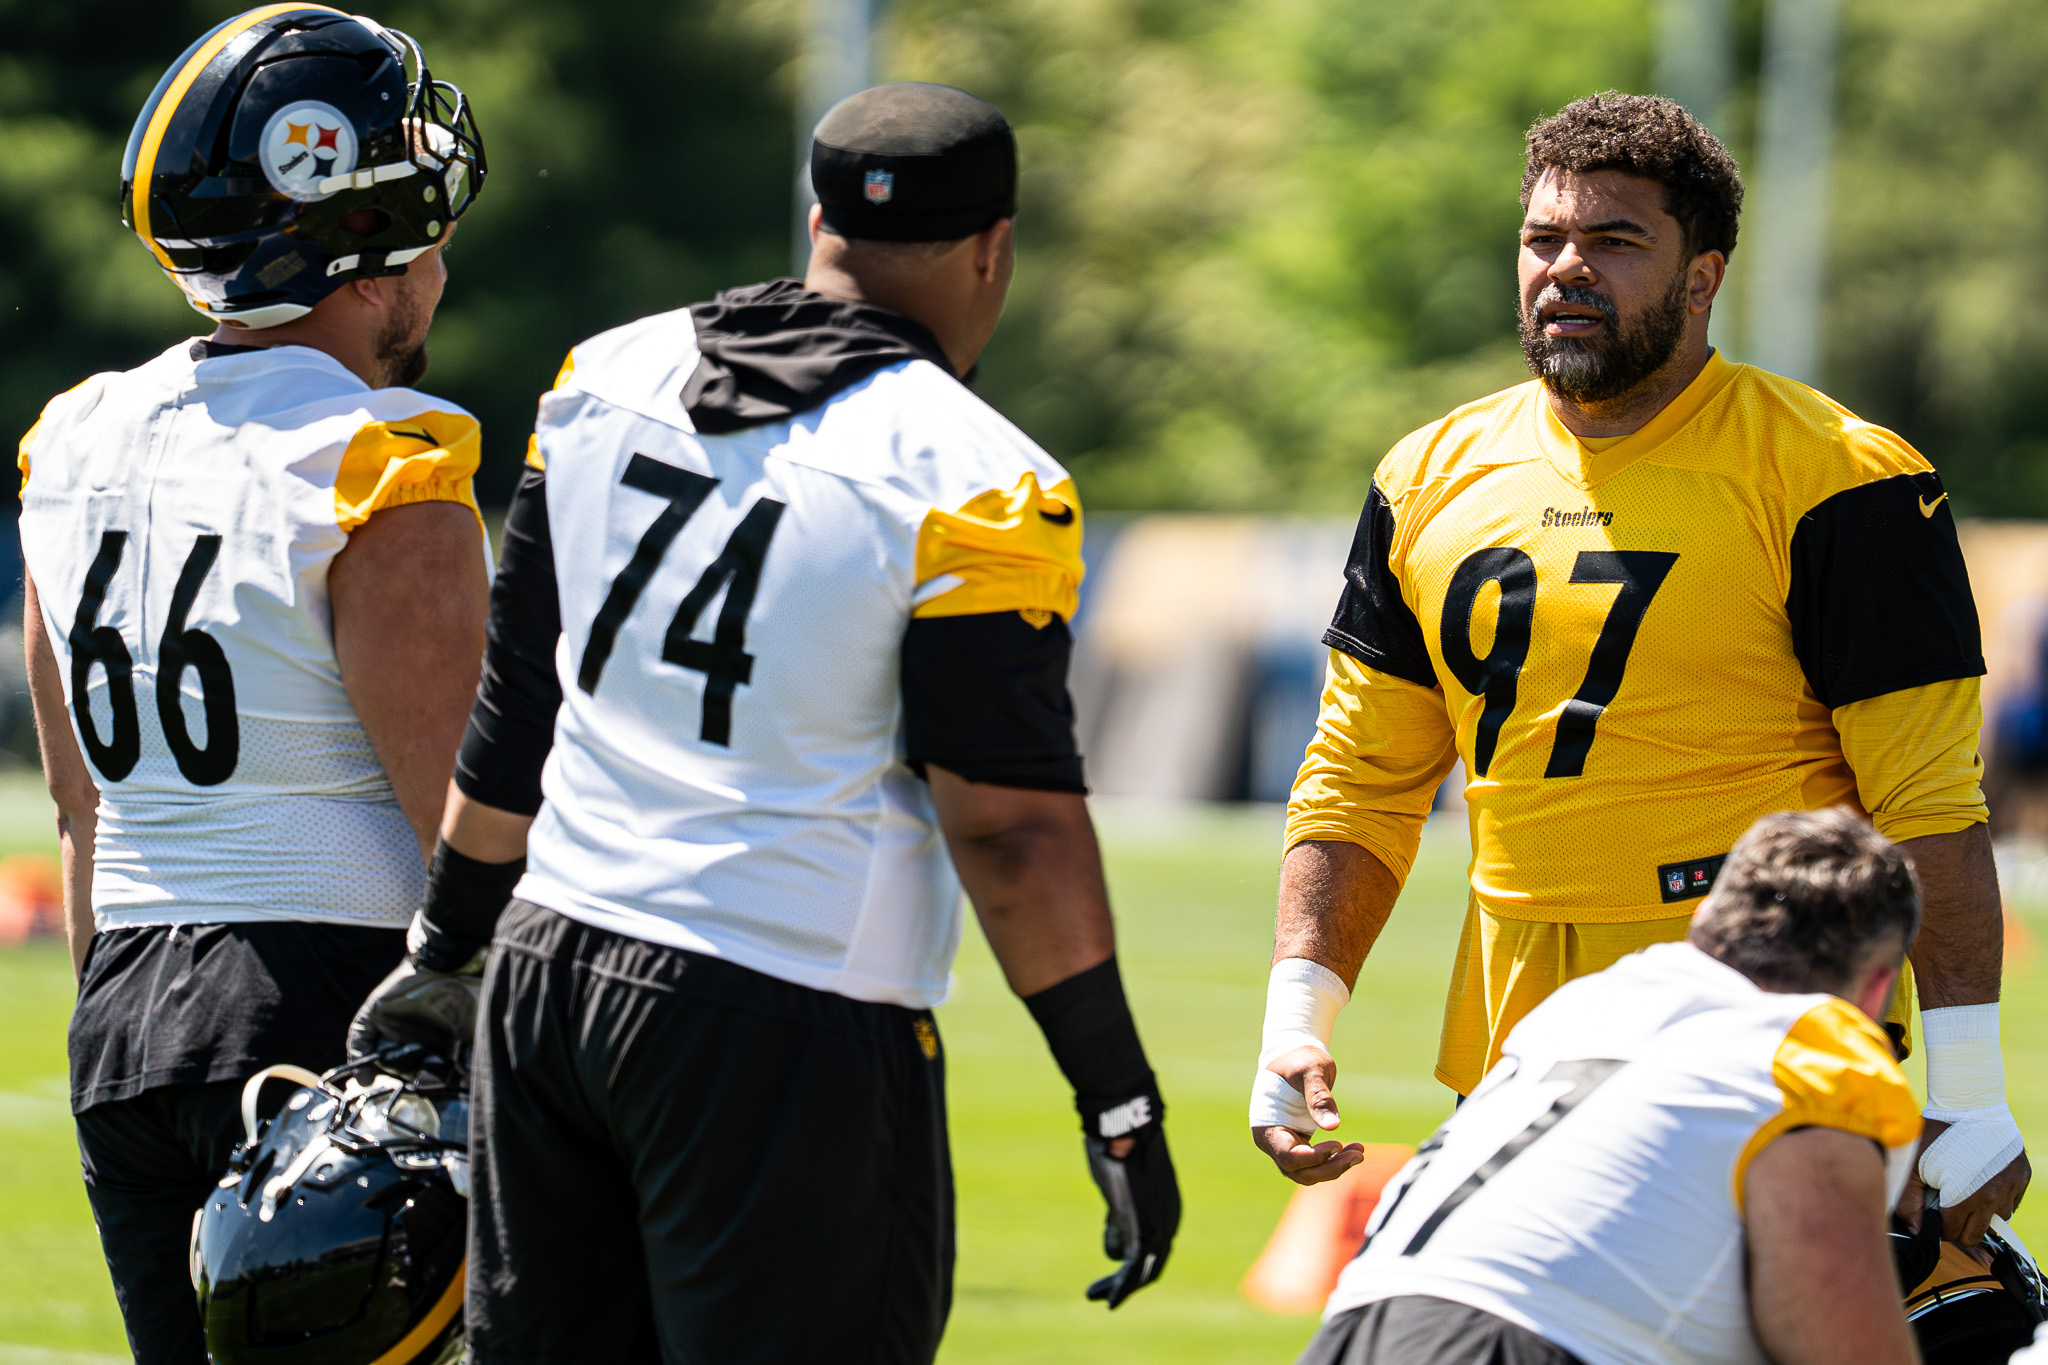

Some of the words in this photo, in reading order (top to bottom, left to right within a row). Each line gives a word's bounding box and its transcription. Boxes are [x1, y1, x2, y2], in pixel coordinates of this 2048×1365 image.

[577, 452, 786, 747] 74
[1541, 506, 1613, 527] Steelers
[69, 531, 239, 786] 66
[1440, 546, 1681, 779] 97
[1099, 1096, 1152, 1138] NIKE
